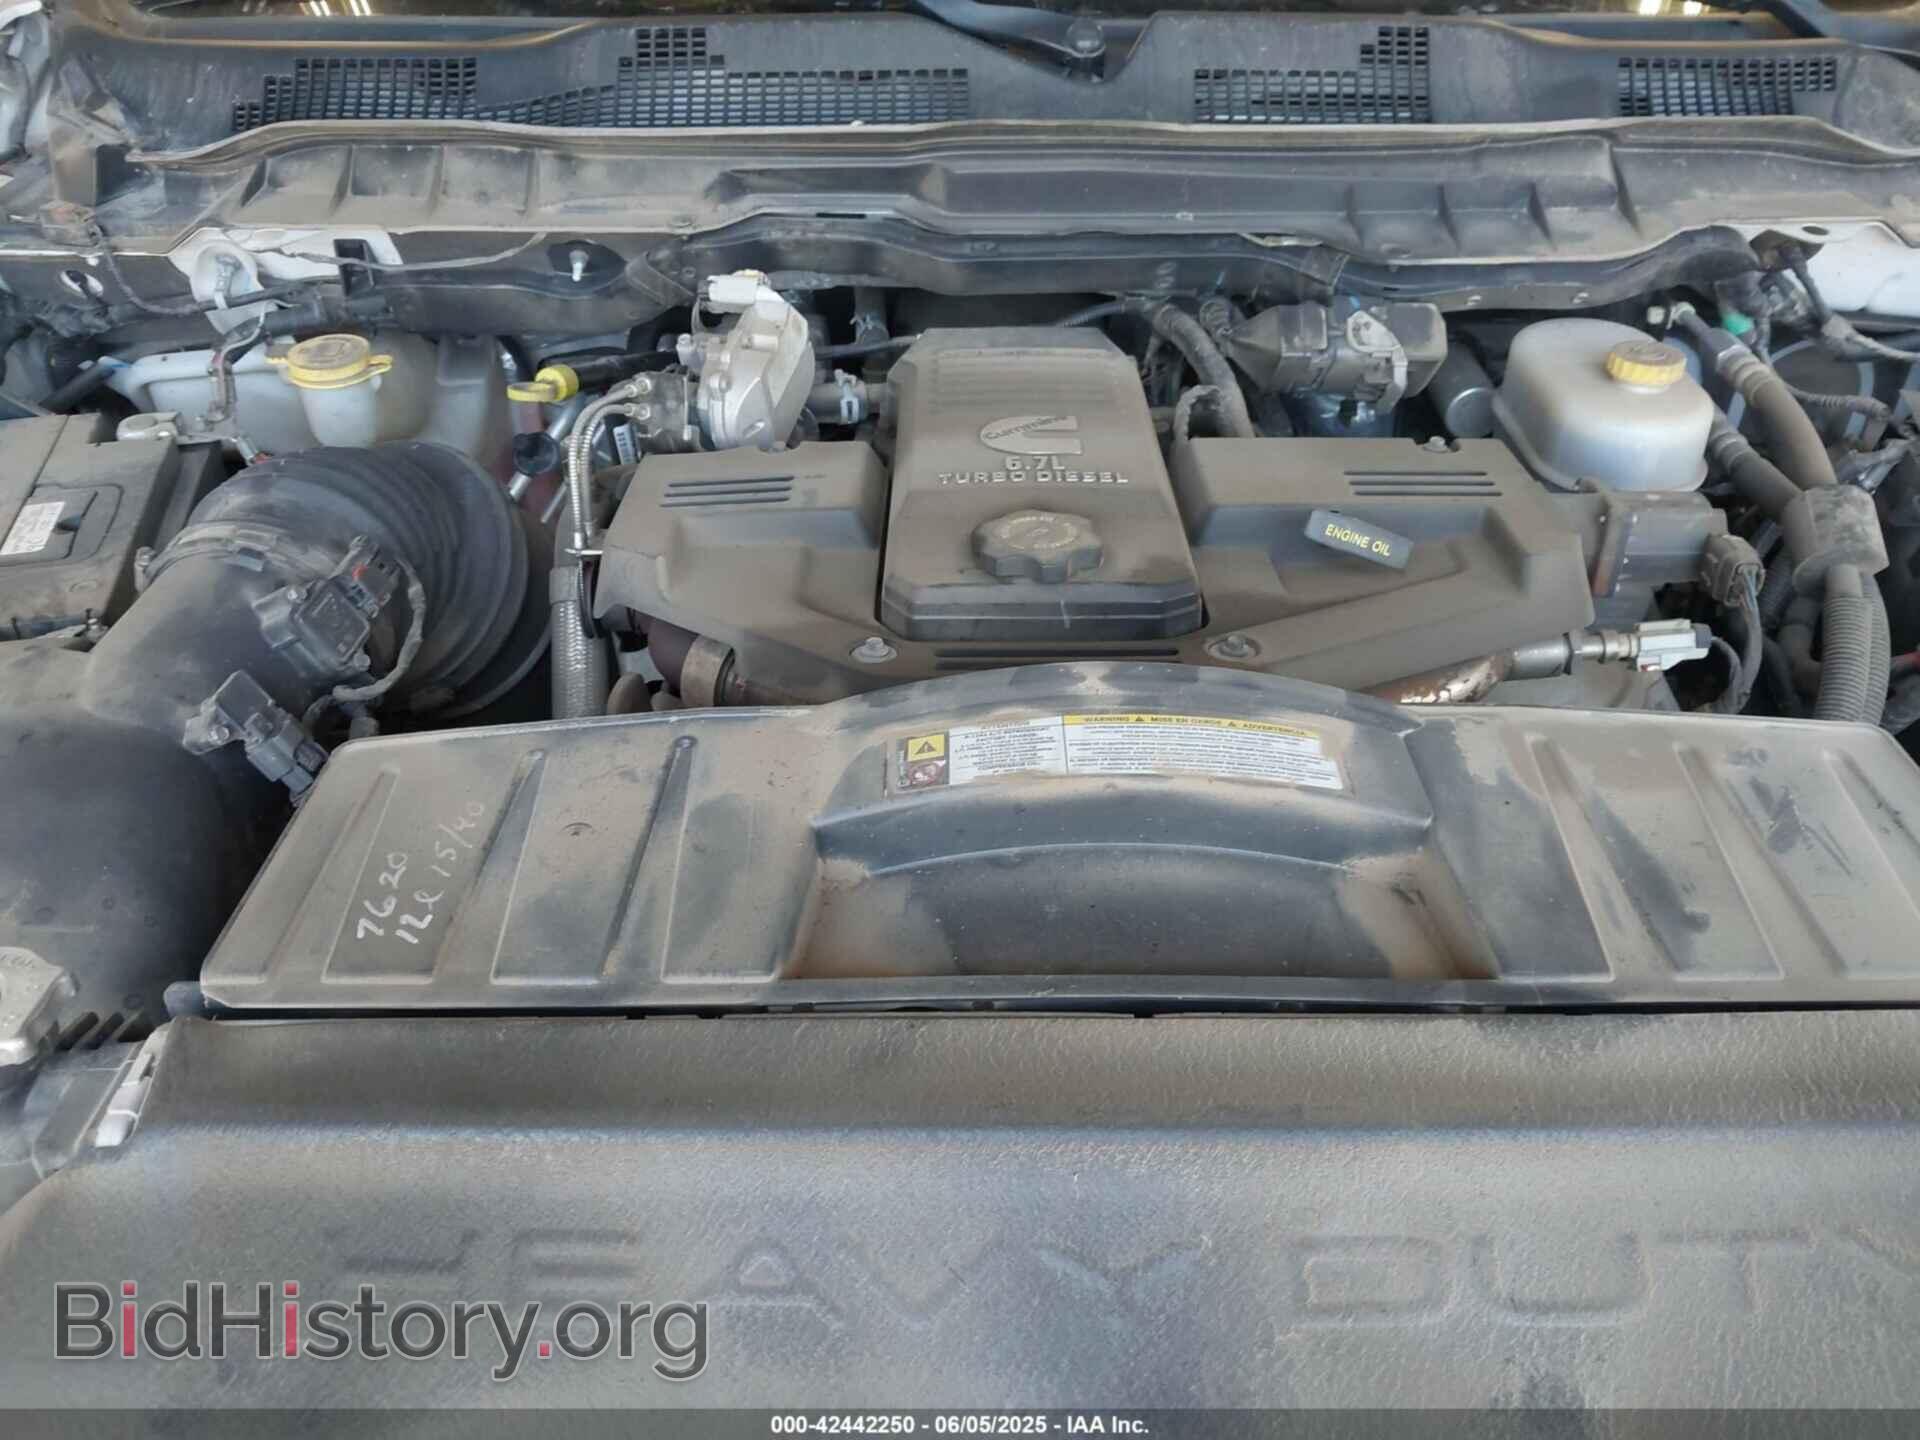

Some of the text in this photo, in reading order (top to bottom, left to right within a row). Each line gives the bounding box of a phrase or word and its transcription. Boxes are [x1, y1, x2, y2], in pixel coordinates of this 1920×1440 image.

[1005, 456, 1066, 471] 6.7L
[939, 472, 1129, 484] TURBO DIESEL
[1325, 523, 1391, 557] ENGINE OIL
